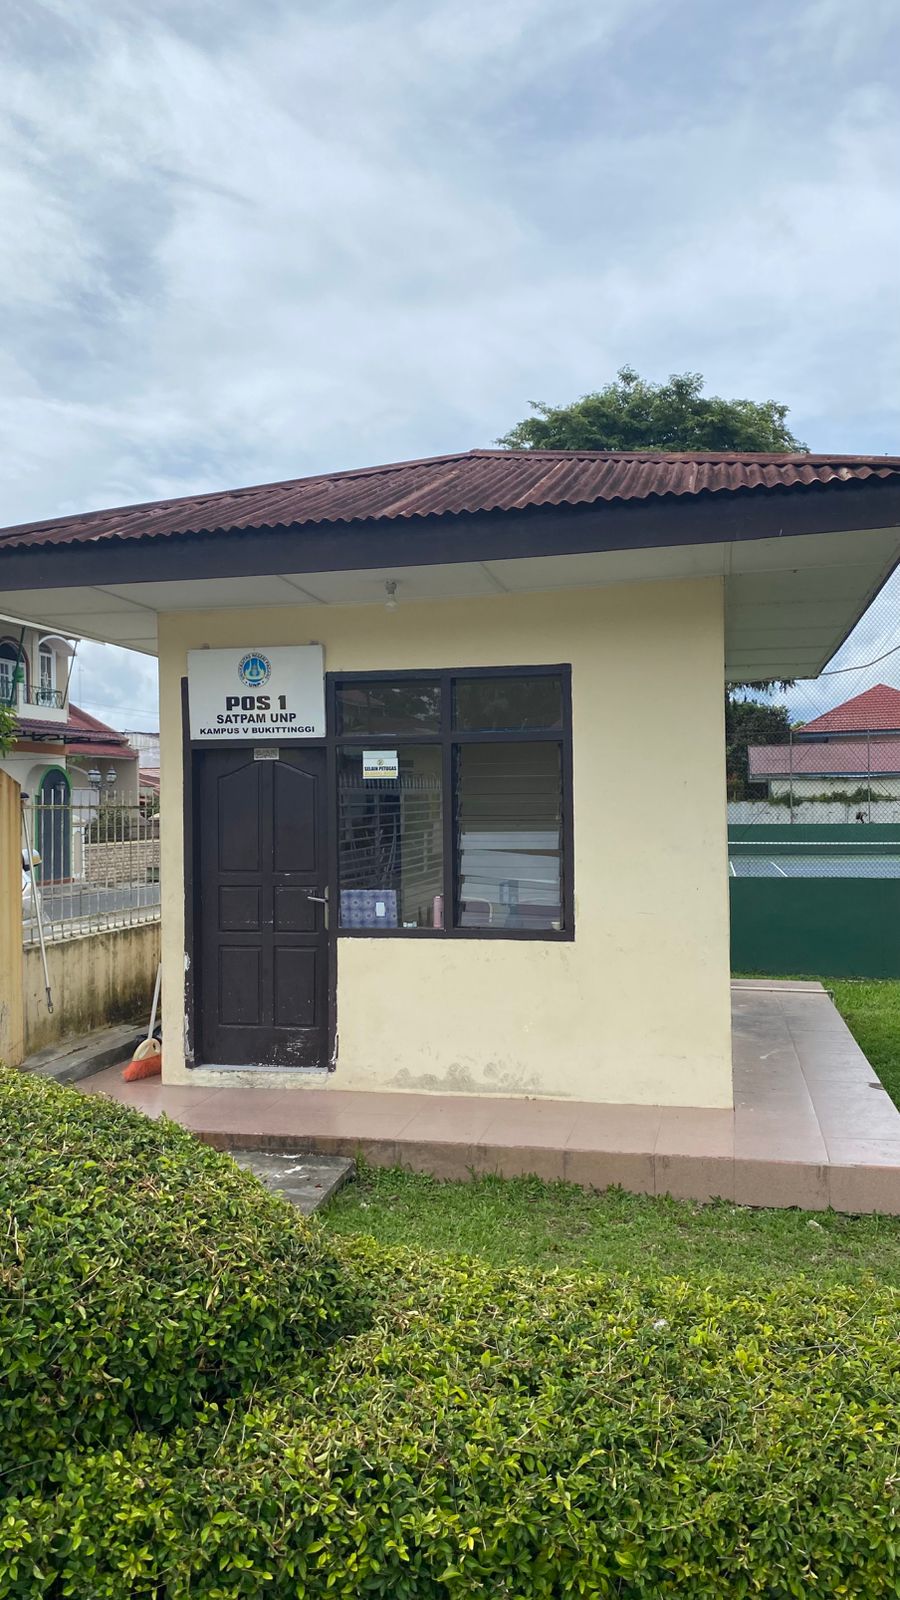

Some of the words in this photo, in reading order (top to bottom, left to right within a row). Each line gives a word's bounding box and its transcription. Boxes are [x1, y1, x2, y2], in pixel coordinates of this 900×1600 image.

[226, 696, 270, 711] POS
[278, 695, 286, 710] 1
[217, 714, 266, 724] SATPAM
[271, 713, 296, 723] UNP
